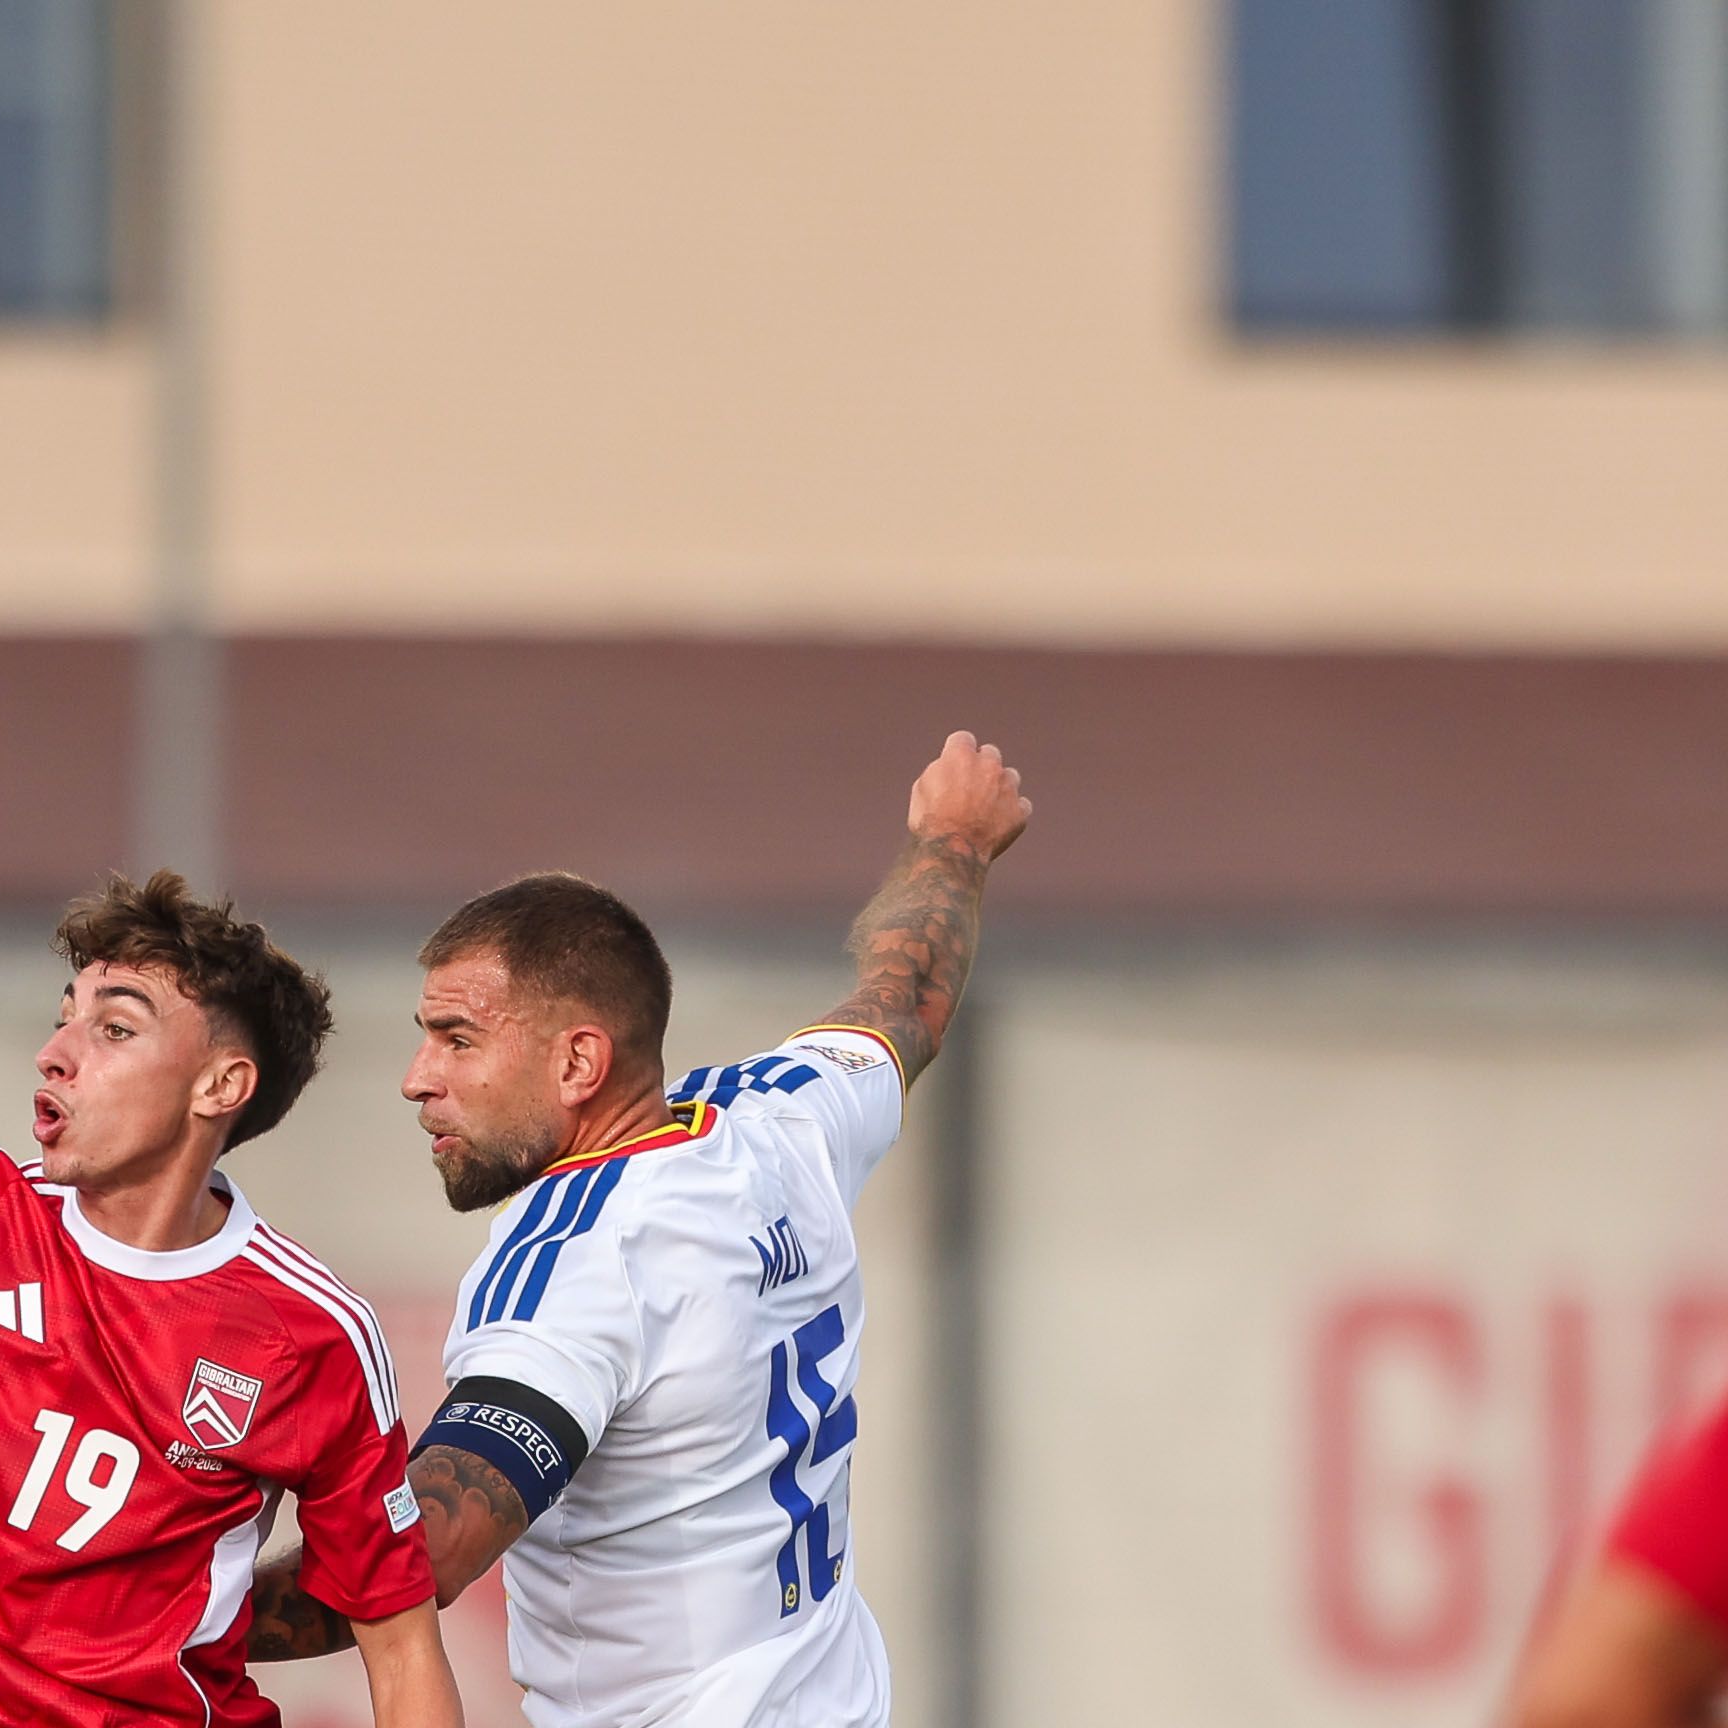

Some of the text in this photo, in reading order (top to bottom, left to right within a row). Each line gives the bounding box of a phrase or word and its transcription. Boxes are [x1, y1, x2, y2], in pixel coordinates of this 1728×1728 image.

[198, 1364, 257, 1397] GIBRALTAR
[473, 1407, 559, 1471] RESPECT
[7, 1408, 141, 1552] 19
